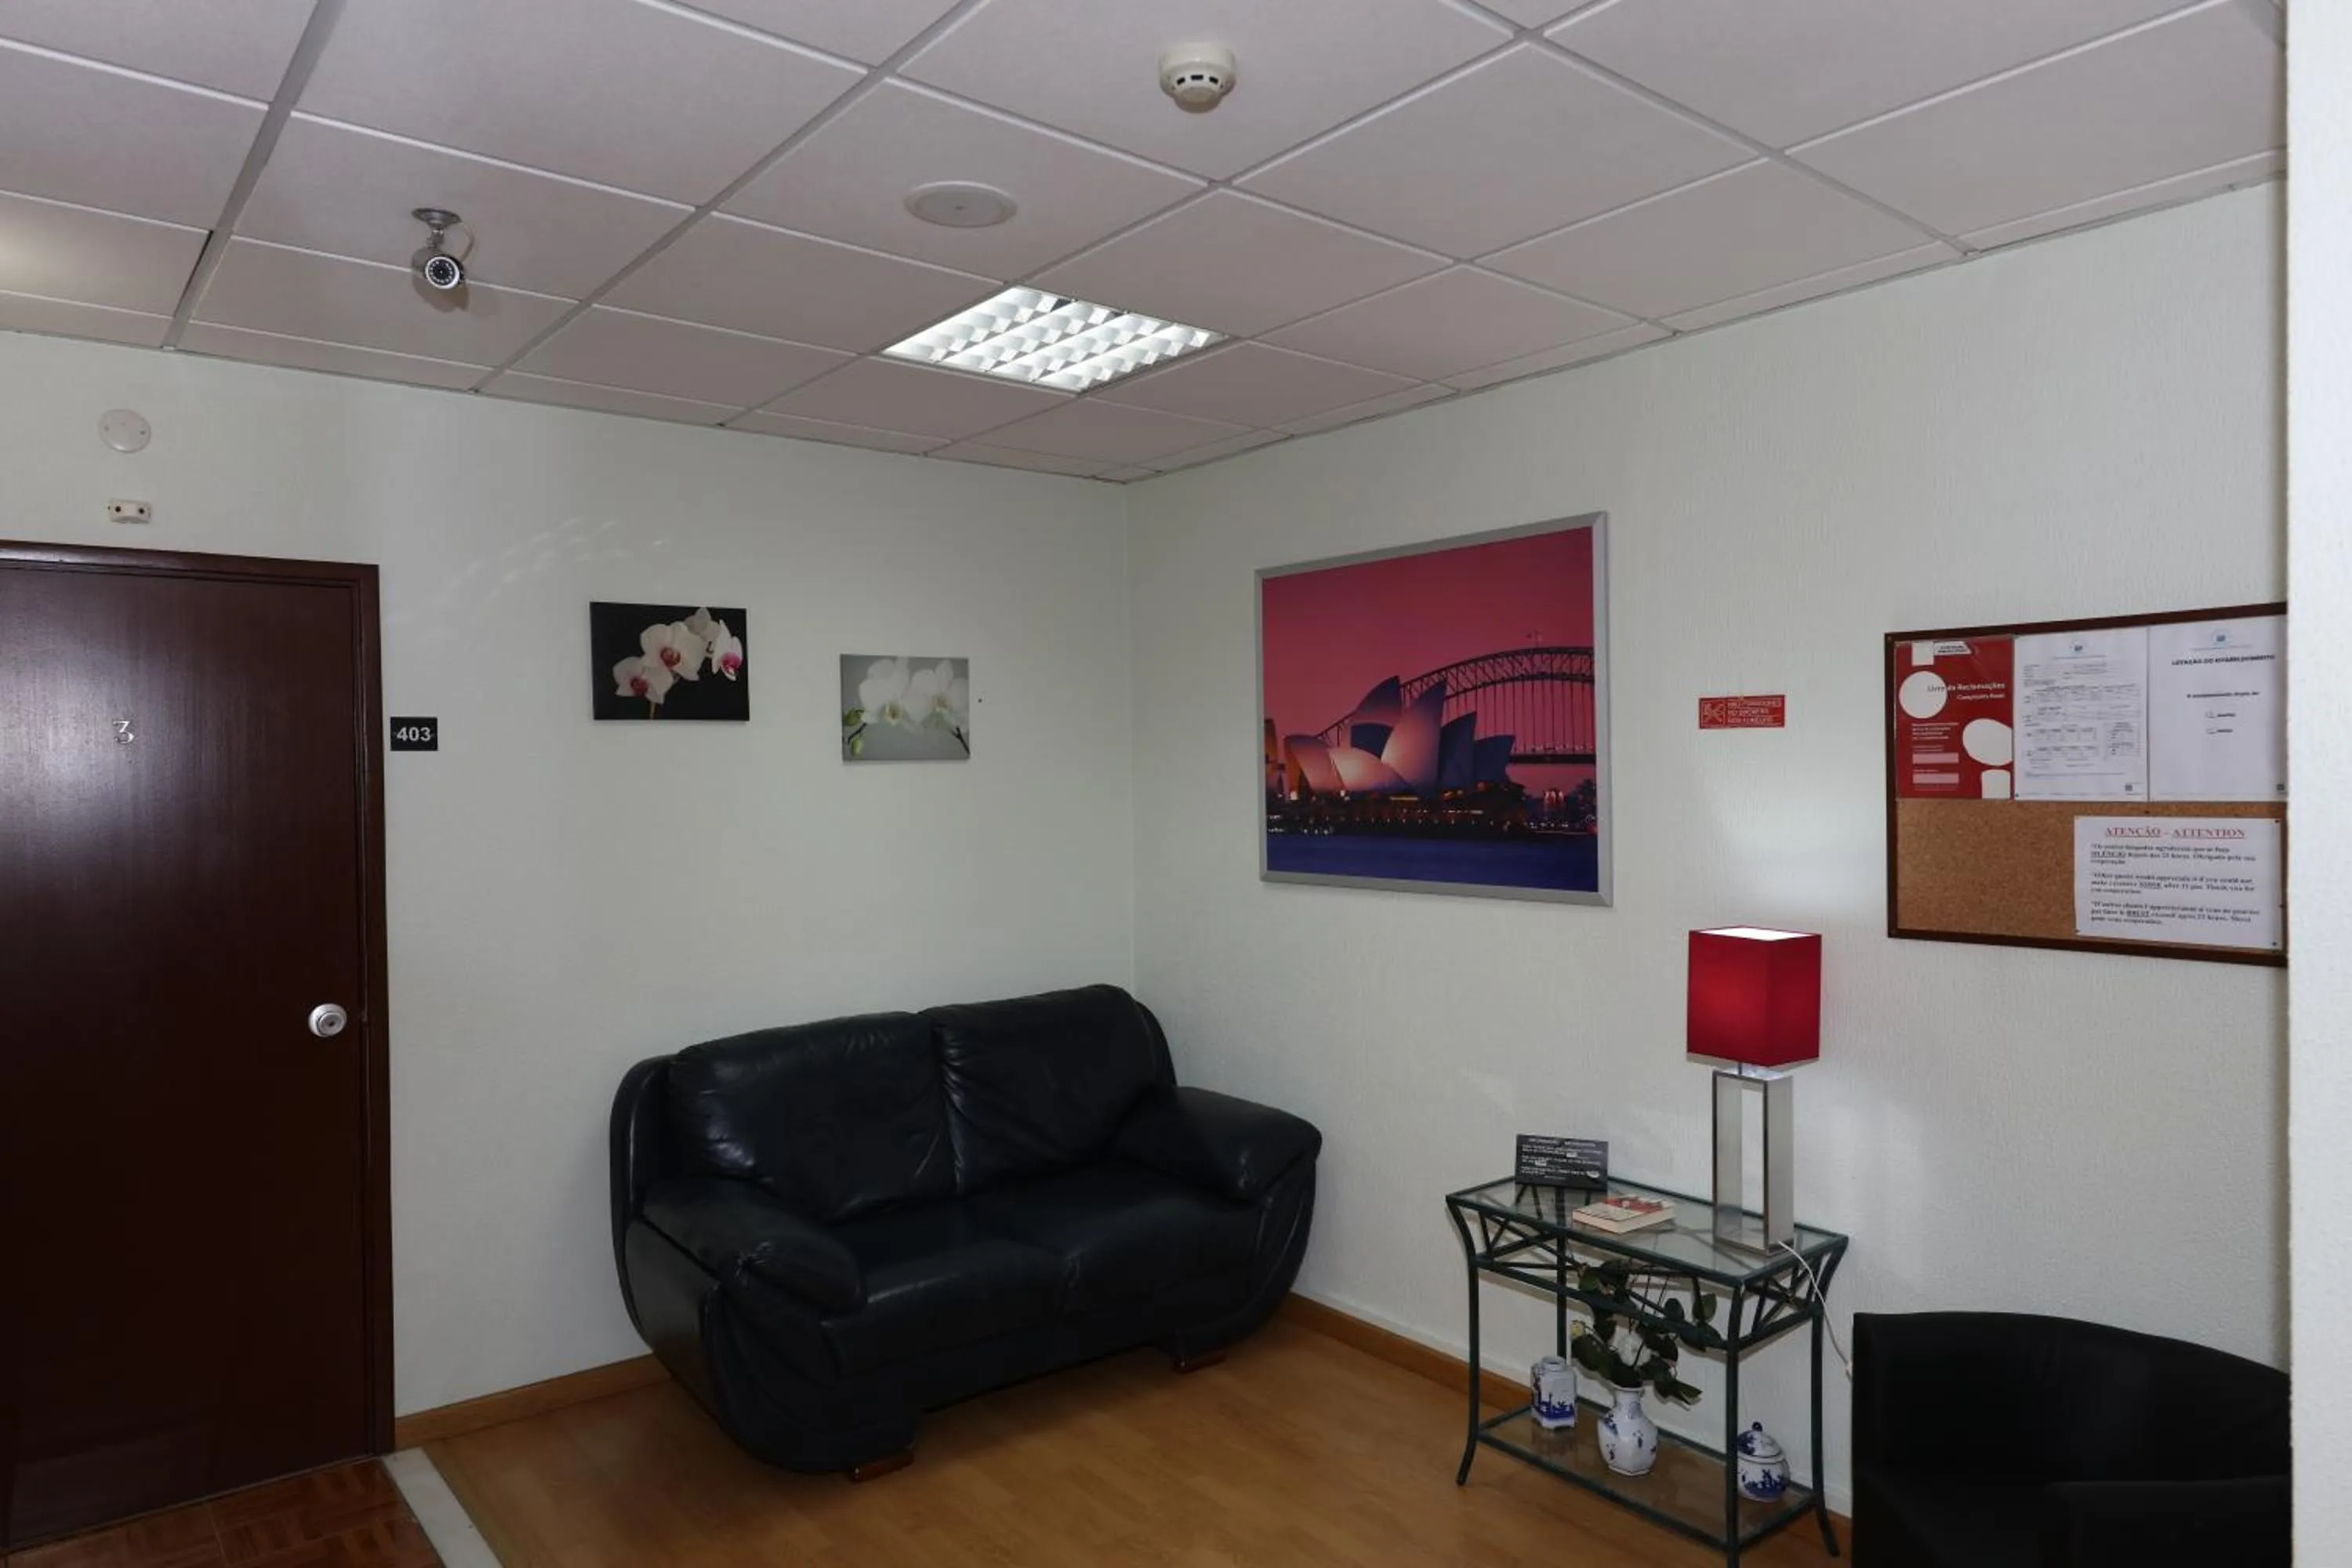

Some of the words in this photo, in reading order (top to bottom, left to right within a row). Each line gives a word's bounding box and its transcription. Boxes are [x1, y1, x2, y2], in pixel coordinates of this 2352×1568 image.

[112, 717, 135, 745] 3
[396, 726, 431, 741] 403
[2104, 826, 2161, 838] ATENÇÃO
[2172, 828, 2246, 840] ATTENTION
